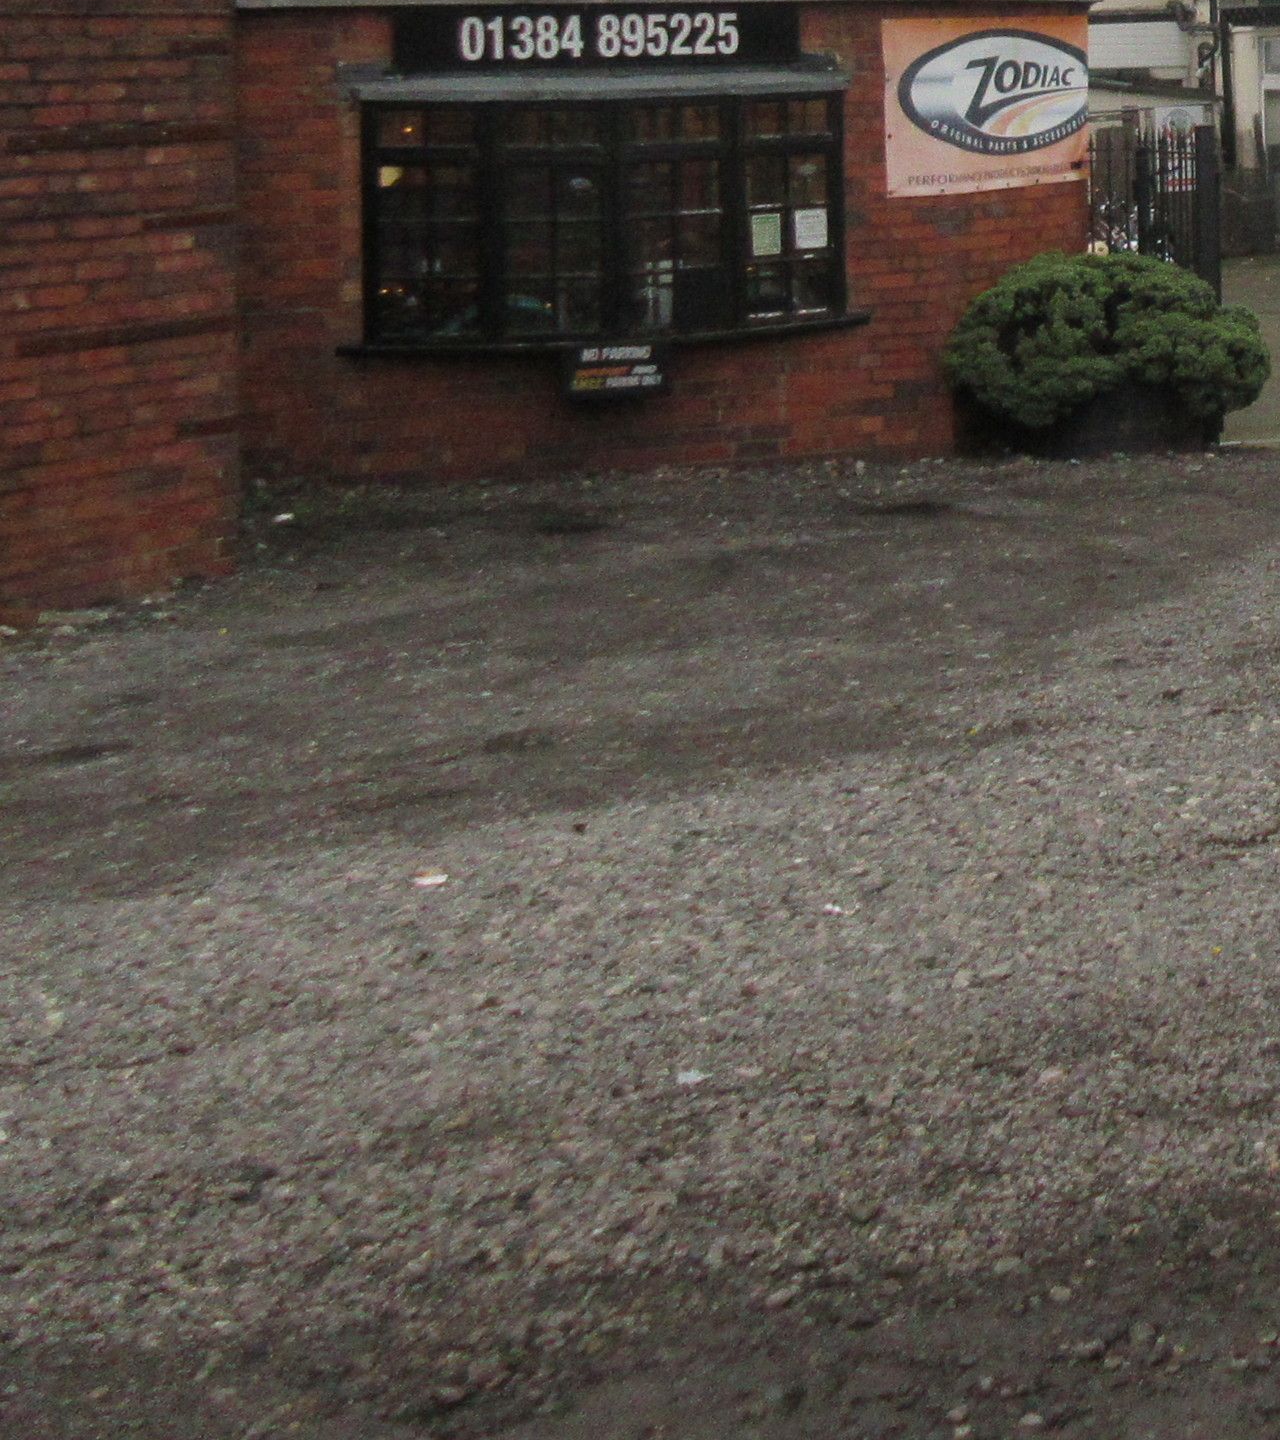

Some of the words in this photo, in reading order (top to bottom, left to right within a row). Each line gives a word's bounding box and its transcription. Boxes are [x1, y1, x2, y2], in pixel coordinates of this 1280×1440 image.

[460, 14, 584, 61] 01384
[596, 12, 740, 58] 895225
[965, 55, 1075, 128] ZODIAC
[931, 119, 984, 149] ORIGINAL
[988, 140, 1019, 152] PARTS
